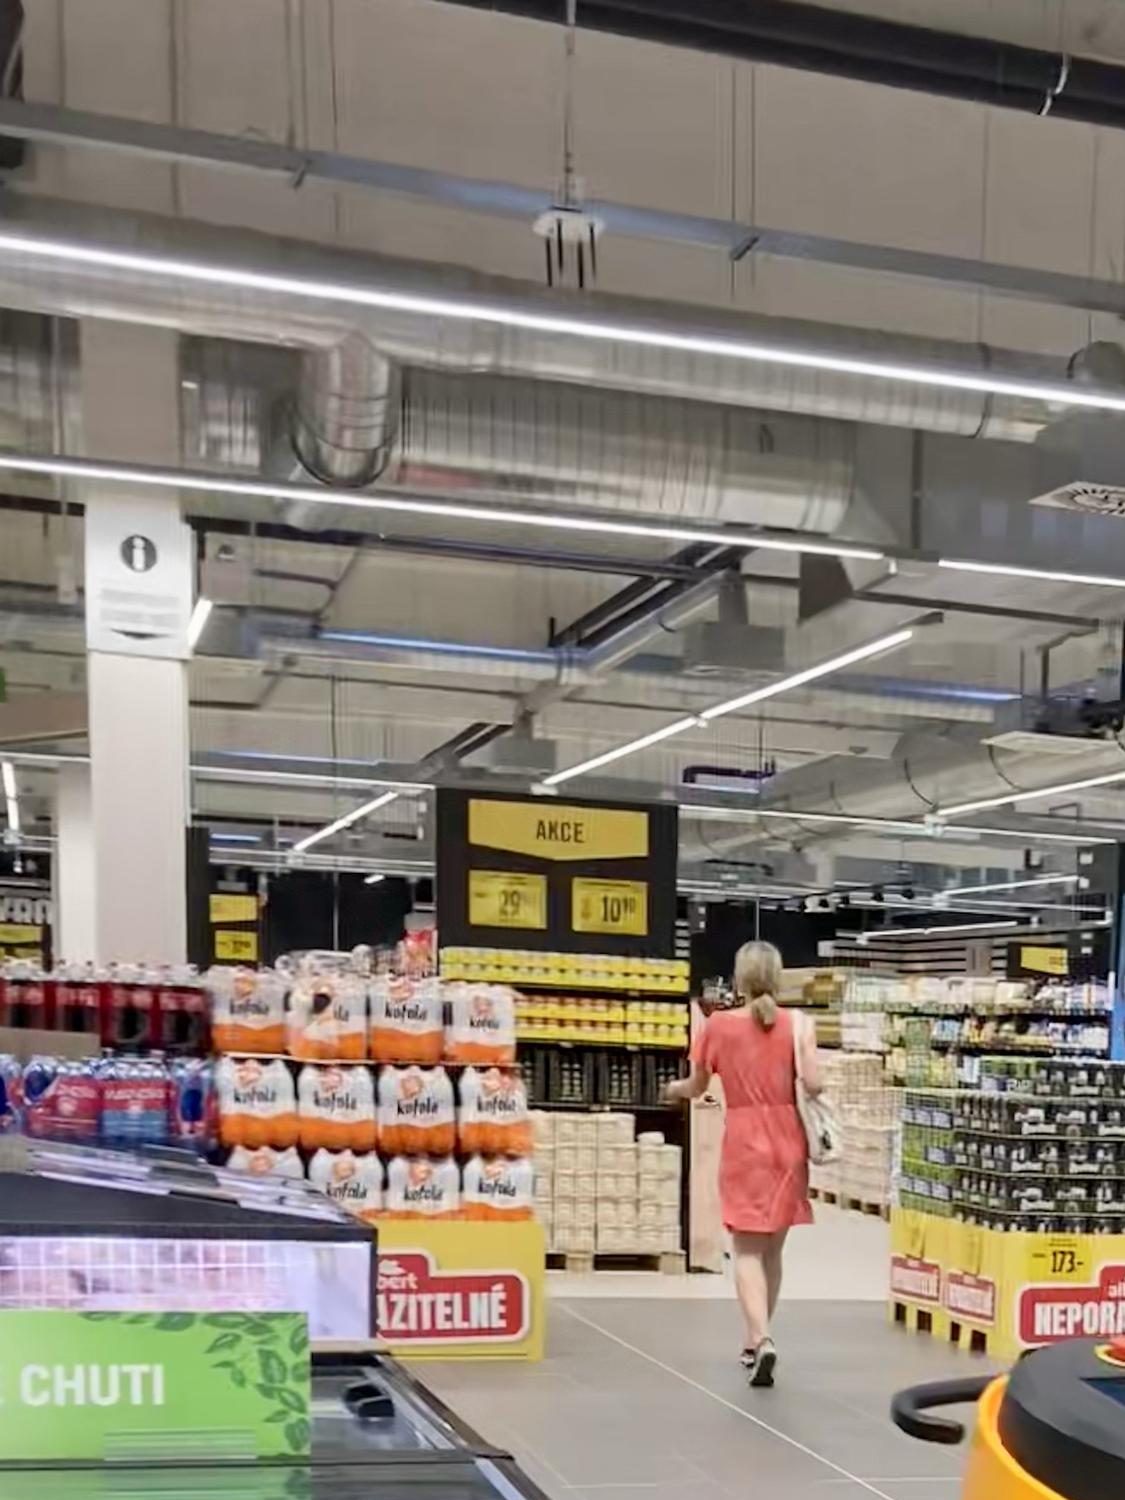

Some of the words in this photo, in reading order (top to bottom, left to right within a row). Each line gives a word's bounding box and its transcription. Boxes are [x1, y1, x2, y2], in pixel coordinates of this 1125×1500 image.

[535, 819, 585, 844] AKCE
[229, 999, 269, 1020] kofola
[384, 1001, 429, 1024] kofola
[469, 1017, 501, 1036] kofola
[233, 1088, 277, 1111] kofola
[313, 1091, 357, 1111] kofola
[396, 1097, 439, 1117] kofola
[476, 1095, 516, 1114] kofola
[325, 1180, 368, 1206] kofola
[403, 1182, 445, 1205] kofola
[478, 1177, 517, 1200] kofola
[20, 1363, 165, 1406] CHUTI
